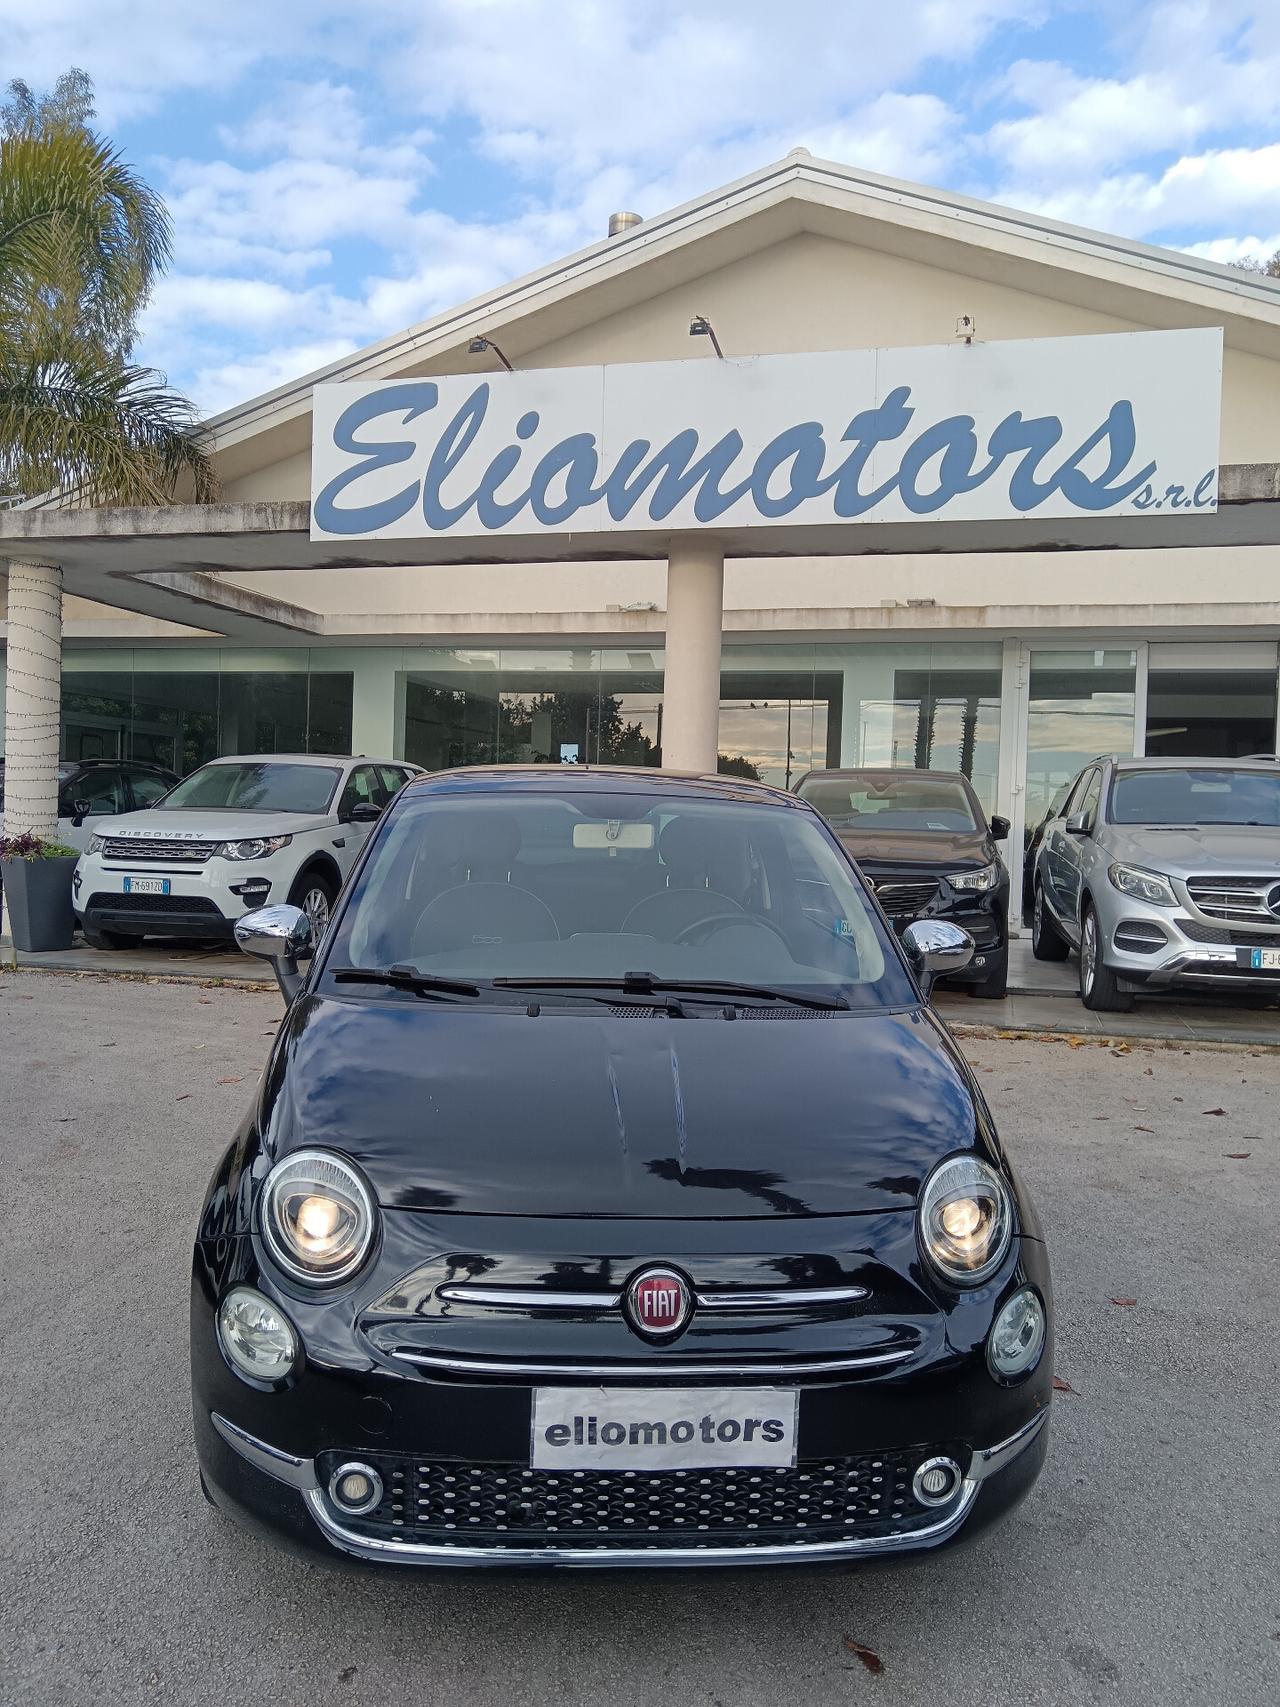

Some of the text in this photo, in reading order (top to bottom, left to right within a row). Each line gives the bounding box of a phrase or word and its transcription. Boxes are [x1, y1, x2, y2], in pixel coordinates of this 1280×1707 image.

[313, 382, 1217, 535] Eliomotors s.r.l.
[118, 830, 205, 839] DISCOVERY
[643, 1289, 678, 1318] FIAT
[544, 1413, 785, 1447] eliomotors
